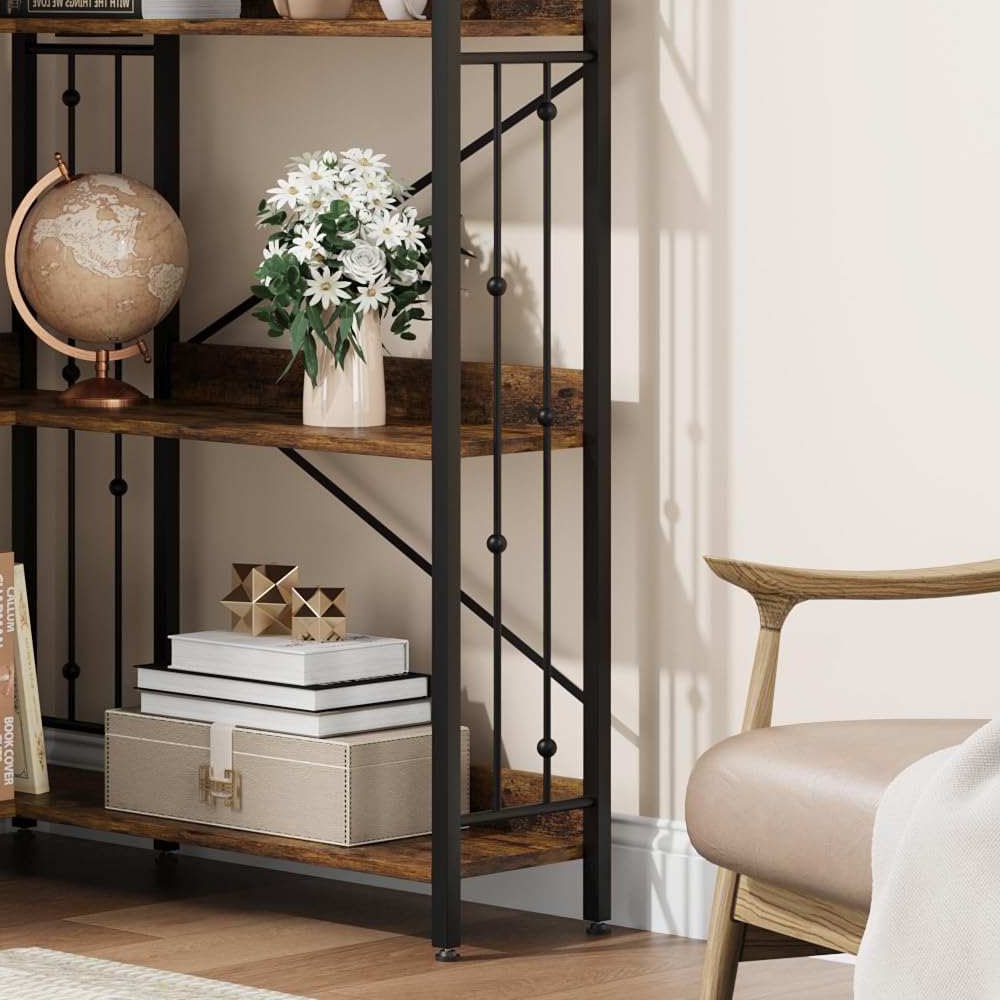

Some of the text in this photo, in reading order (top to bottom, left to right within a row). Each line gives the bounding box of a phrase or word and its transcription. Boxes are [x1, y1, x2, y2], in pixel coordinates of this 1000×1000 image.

[6, 586, 15, 633] CALLUM
[3, 716, 14, 786] BOOK COVER
